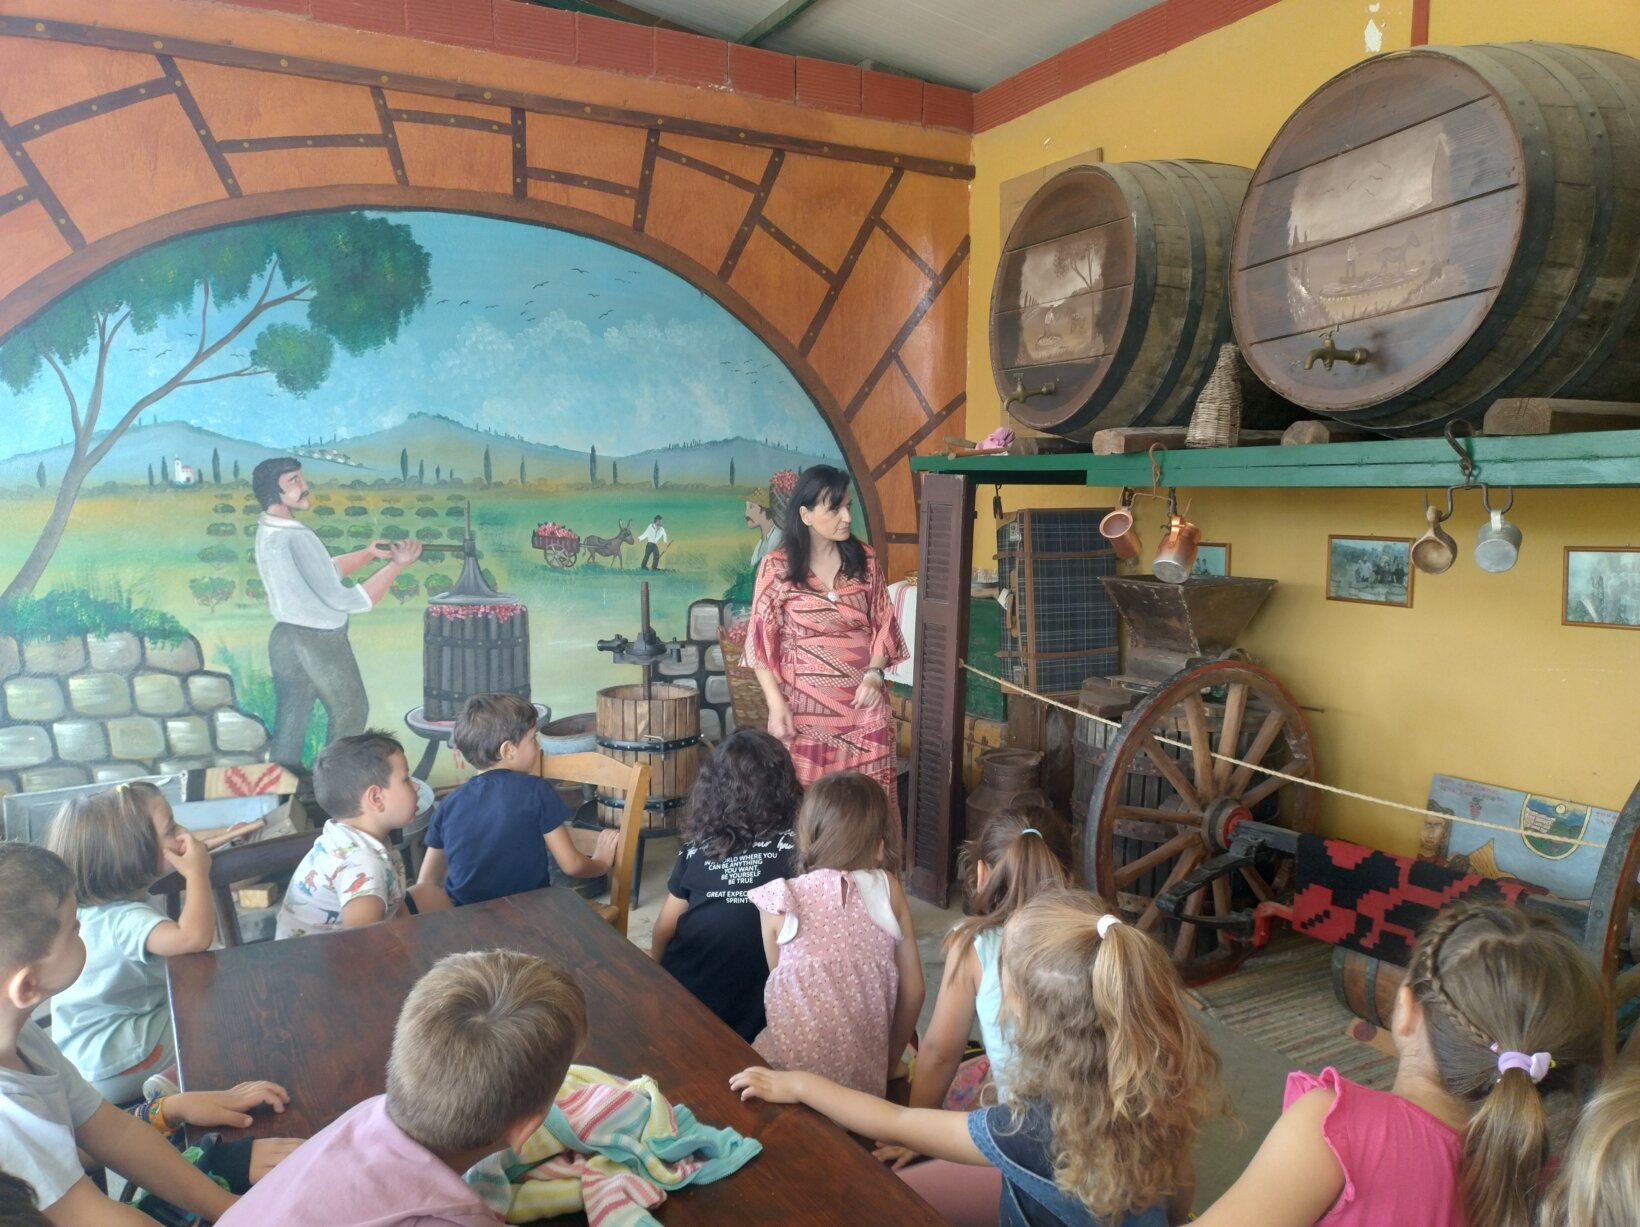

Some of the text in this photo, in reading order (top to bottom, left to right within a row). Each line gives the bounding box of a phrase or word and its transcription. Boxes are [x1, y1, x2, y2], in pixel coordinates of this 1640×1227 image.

[739, 853, 763, 861] WHERE
[708, 863, 721, 871] CAN
[729, 859, 763, 868] ANYTHING
[729, 871, 761, 879] YOURSELF
[726, 890, 748, 898] EXPEC
